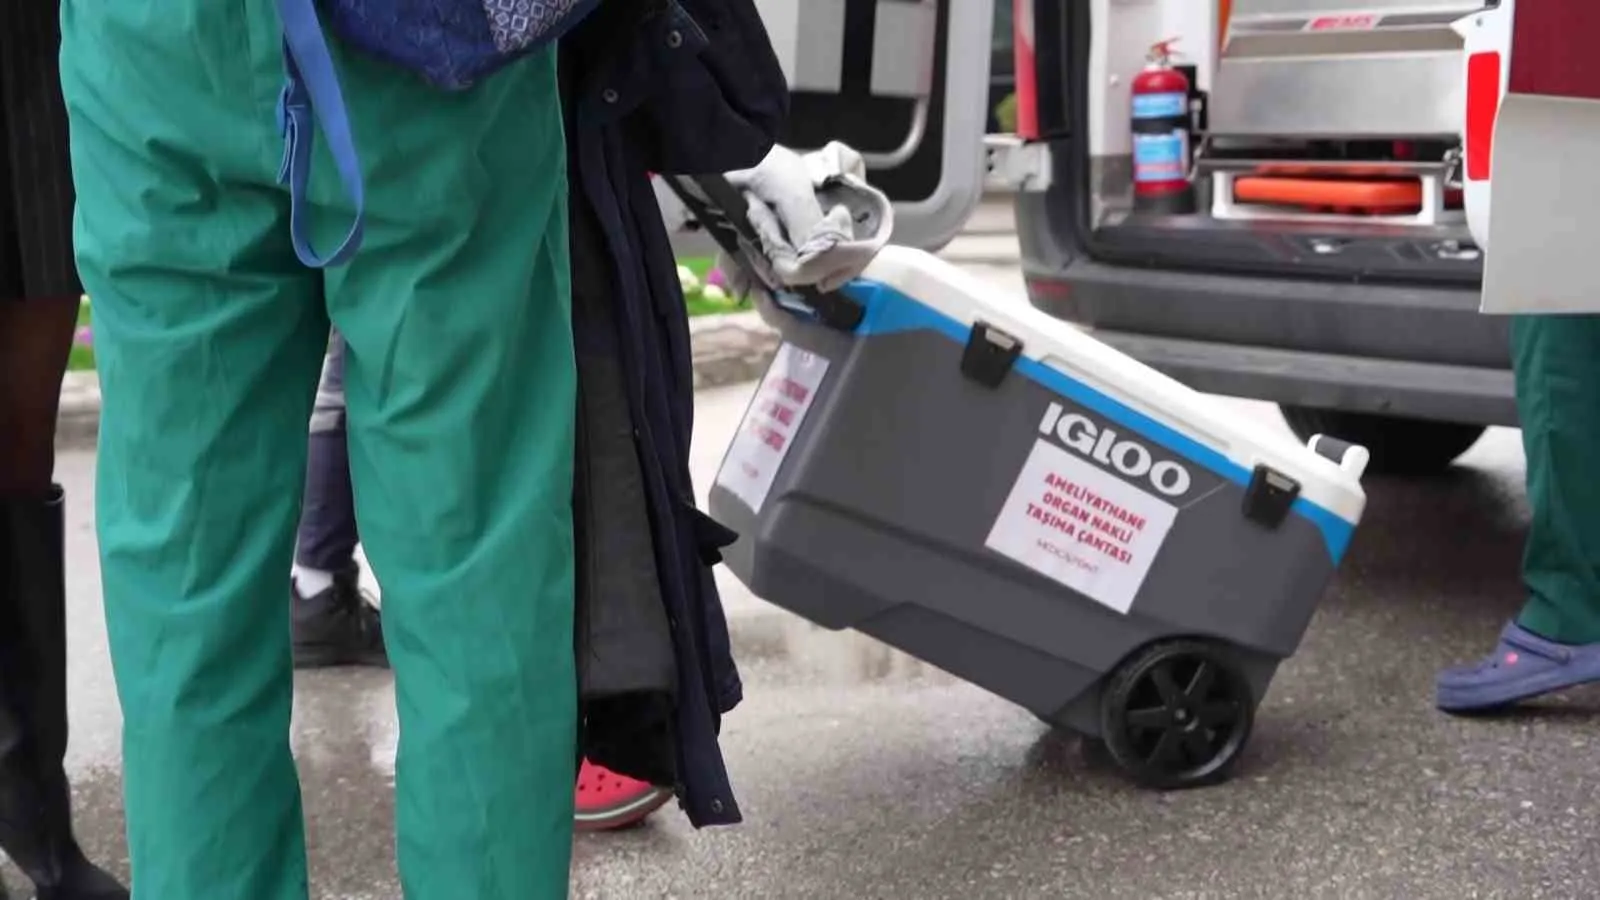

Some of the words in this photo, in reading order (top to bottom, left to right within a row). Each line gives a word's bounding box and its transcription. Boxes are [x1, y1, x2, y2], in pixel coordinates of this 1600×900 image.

[1039, 401, 1190, 496] IGLOO
[1042, 493, 1089, 523] ORGAN
[1091, 515, 1133, 544] NAKLİ
[1044, 473, 1146, 531] AMELİYATHANE
[1026, 503, 1074, 534] TAŞIMA
[1077, 529, 1132, 564] ÇANTASI
